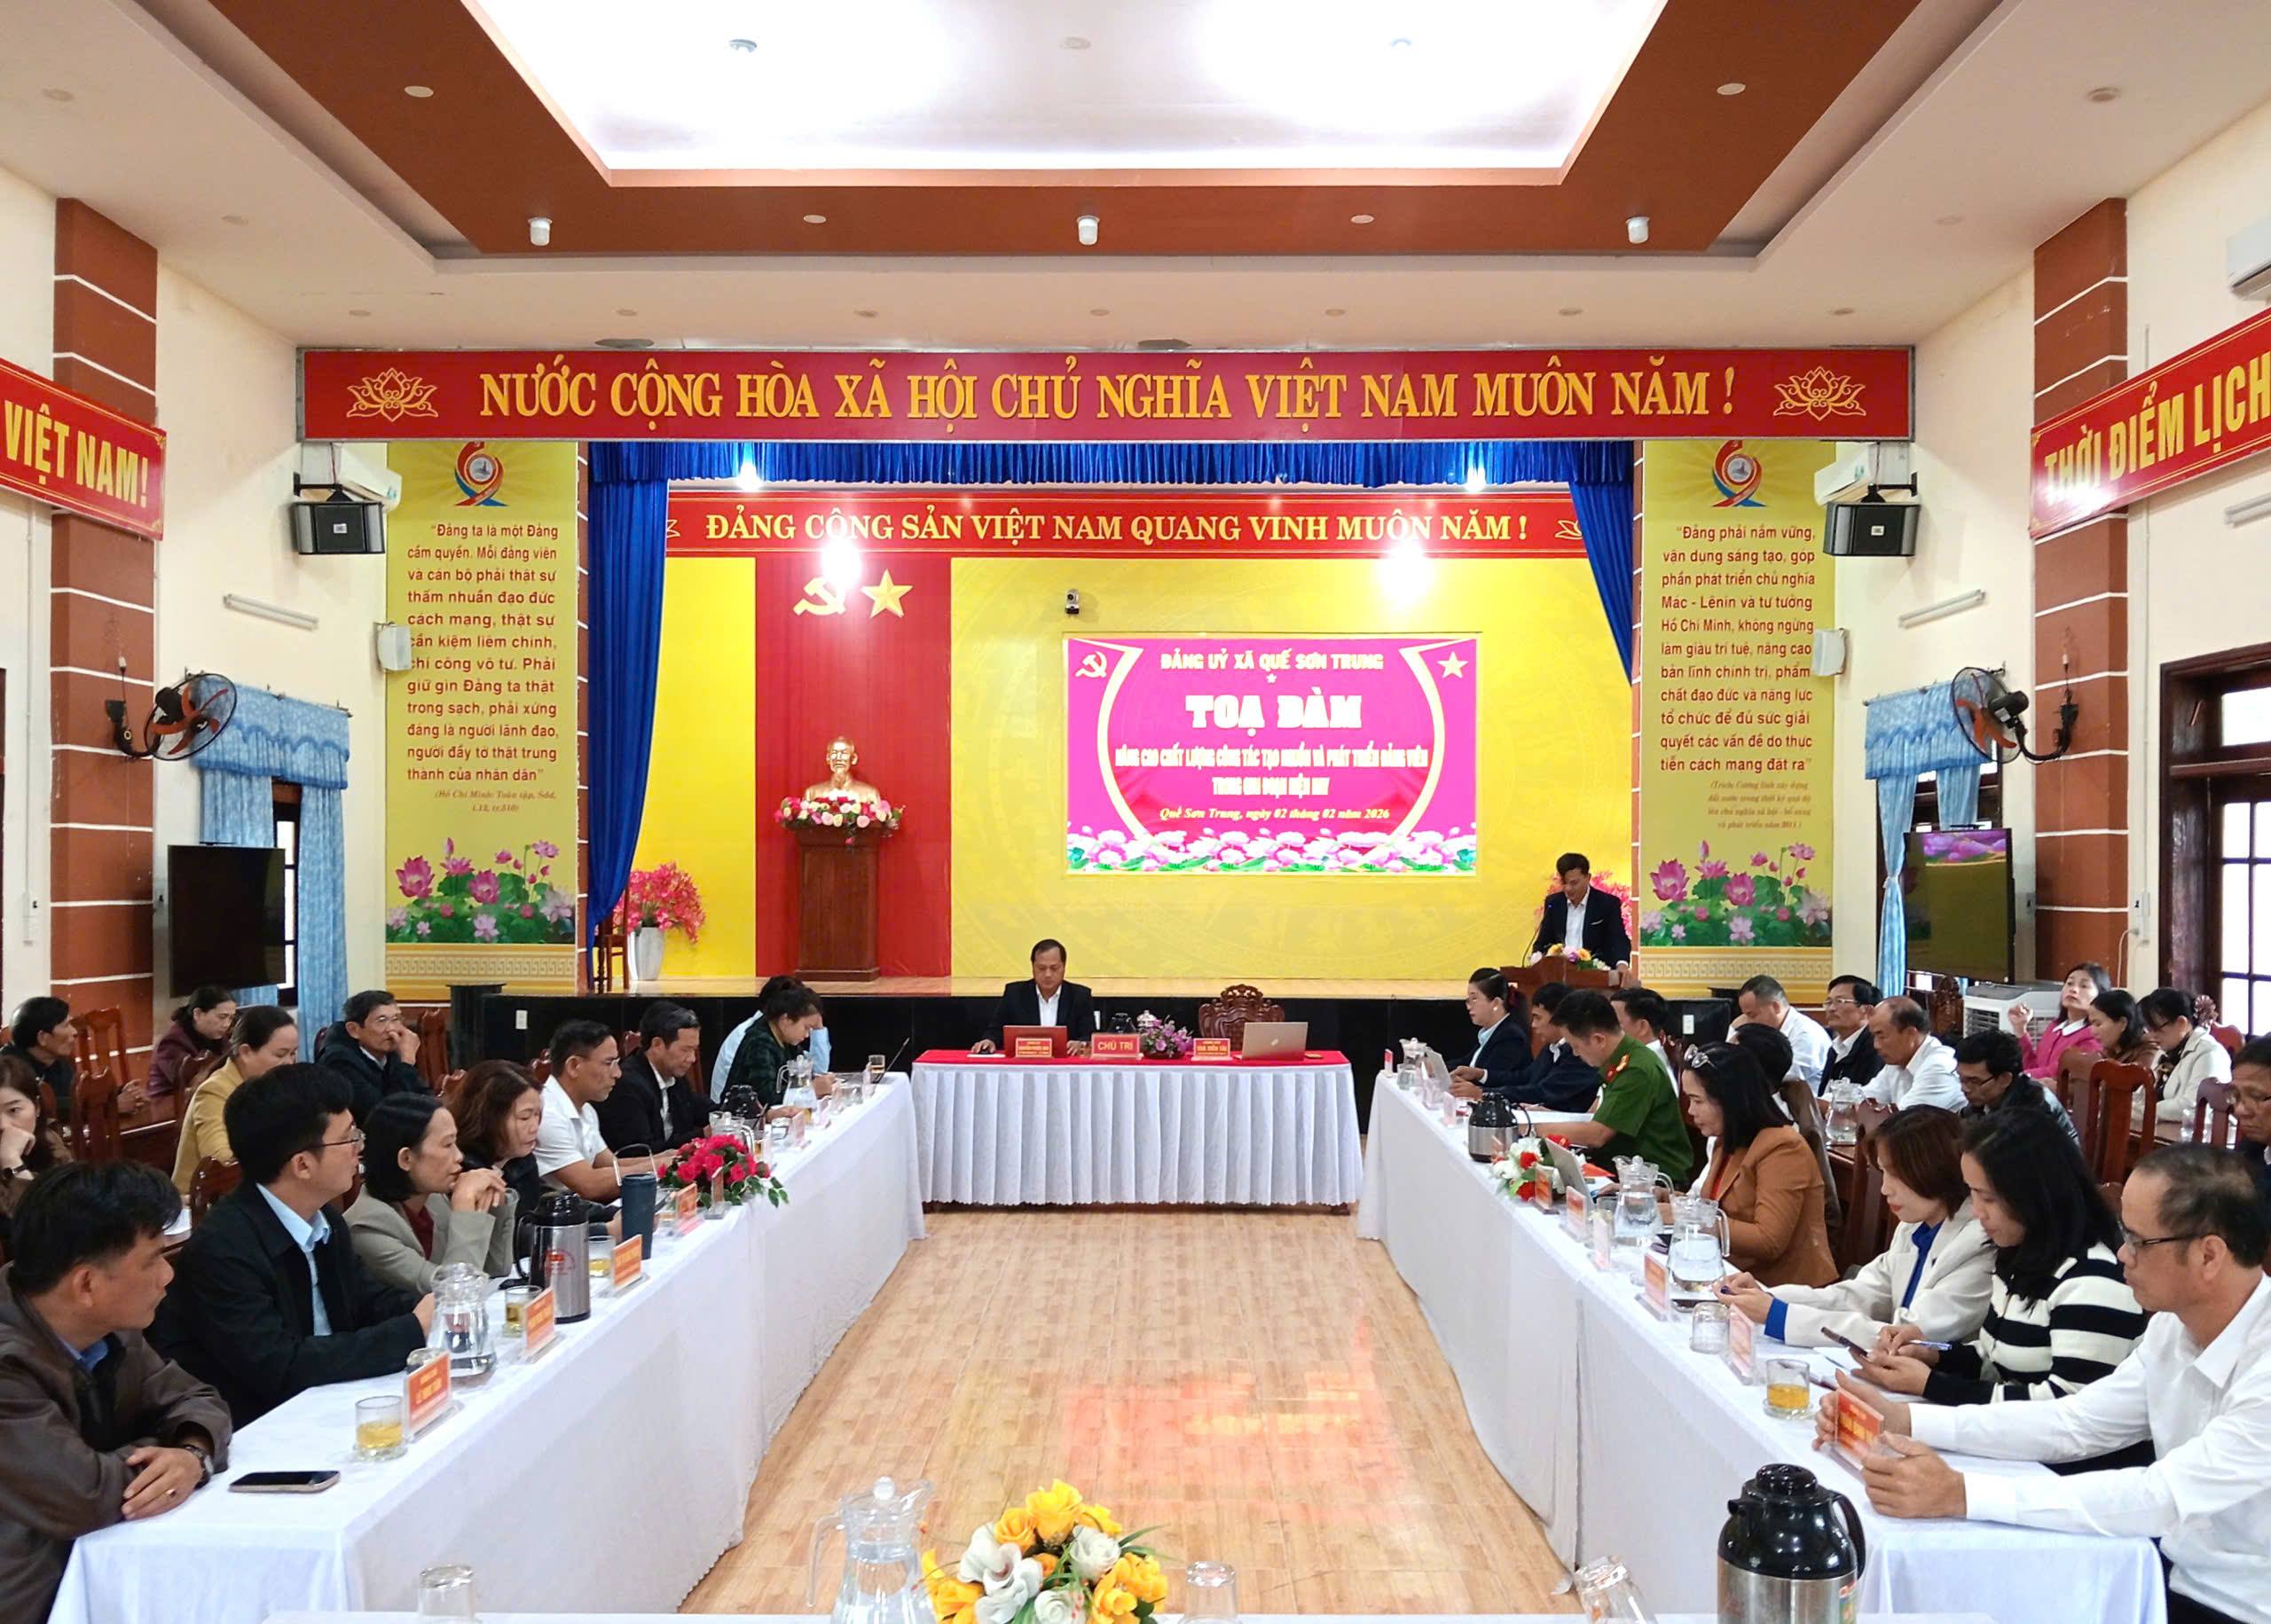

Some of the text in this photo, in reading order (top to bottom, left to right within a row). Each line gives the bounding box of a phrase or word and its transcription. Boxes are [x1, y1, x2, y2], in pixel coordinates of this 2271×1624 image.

[479, 361, 596, 420] NƯỚC
[619, 361, 721, 430] CỘNG
[736, 361, 820, 420] HÒA
[835, 359, 892, 420] XÃ
[908, 362, 978, 432] HỘI
[992, 356, 1080, 420] CHỦ
[1097, 359, 1230, 420] NGHĨA
[1246, 357, 1348, 433] VIỆT
[1362, 373, 1457, 418] NAM
[1473, 357, 1597, 417] MUÔN
[1611, 357, 1709, 416] NĂM
[2110, 381, 2184, 481] ĐIỂM
[2195, 352, 2271, 452] LỊCH
[5, 400, 69, 485] VIỆT
[706, 505, 796, 539] ĐẢNG
[902, 505, 963, 539] SẢN
[970, 507, 1045, 545] VIỆT
[1131, 516, 1241, 545] QUANG
[1337, 509, 1432, 540] MUÔN
[1441, 509, 1510, 540] NĂM
[1259, 648, 1292, 672] QUẾ
[1331, 653, 1384, 670] TRUNG
[1277, 686, 1362, 728] ĐÀM
[1274, 809, 1286, 819] 02
[1323, 809, 1335, 819] 02
[1364, 809, 1390, 819] 2026
